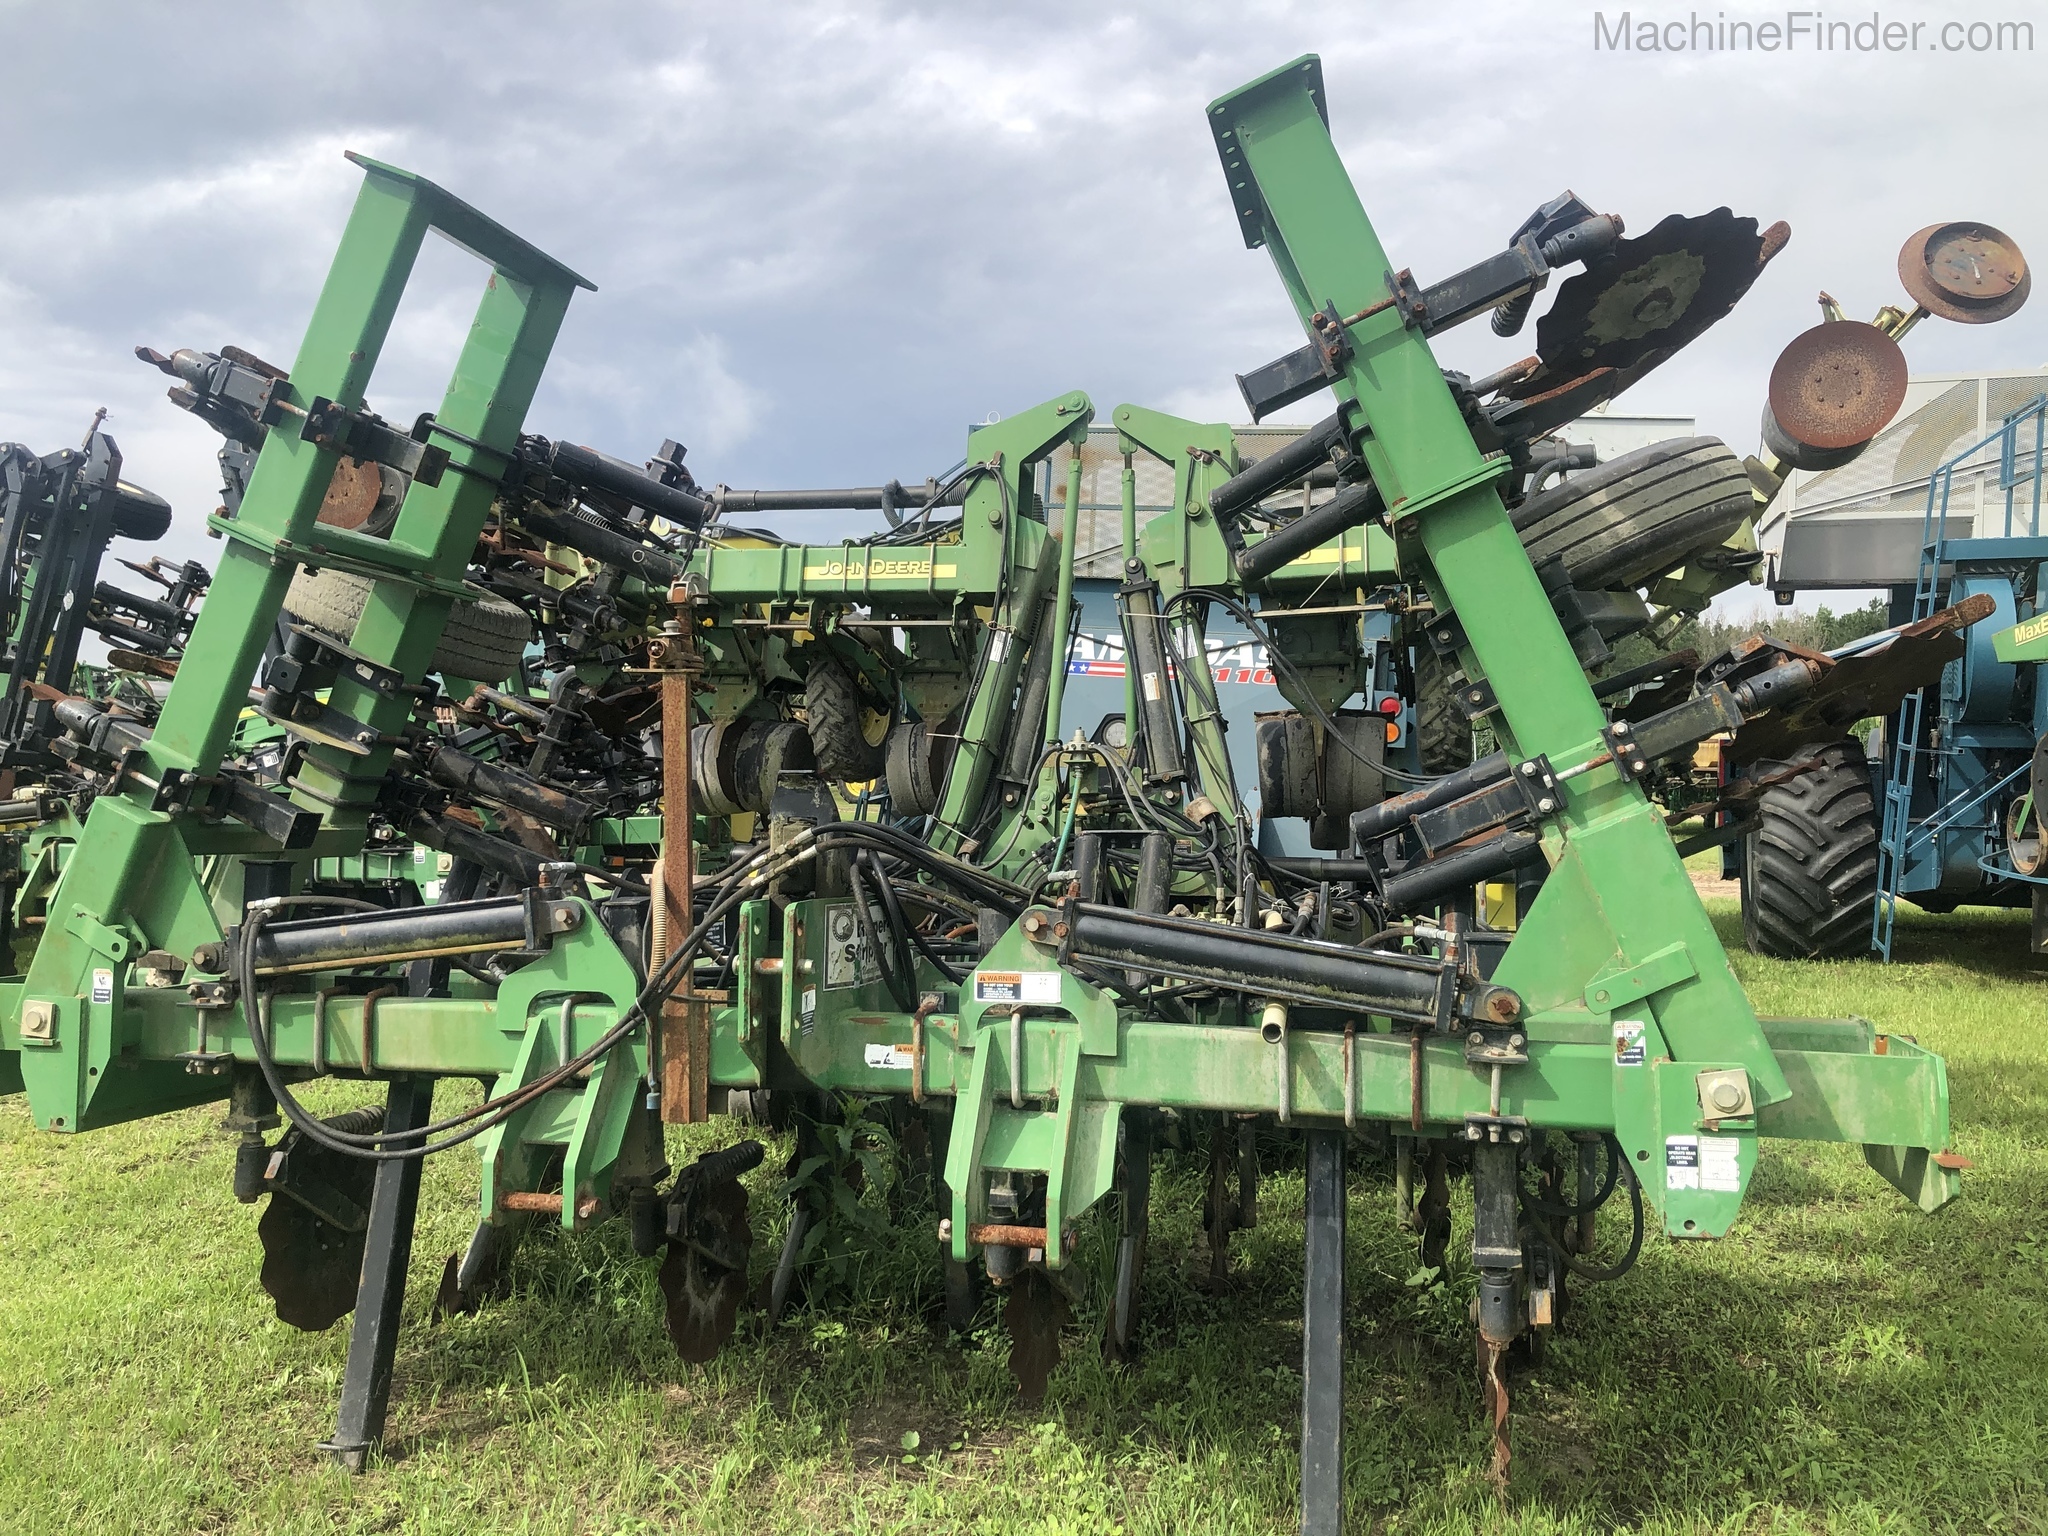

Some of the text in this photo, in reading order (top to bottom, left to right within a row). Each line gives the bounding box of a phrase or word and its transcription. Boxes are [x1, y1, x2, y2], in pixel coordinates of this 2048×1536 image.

[819, 558, 931, 576] JOHN DEERE
[1209, 667, 1277, 686] 110
